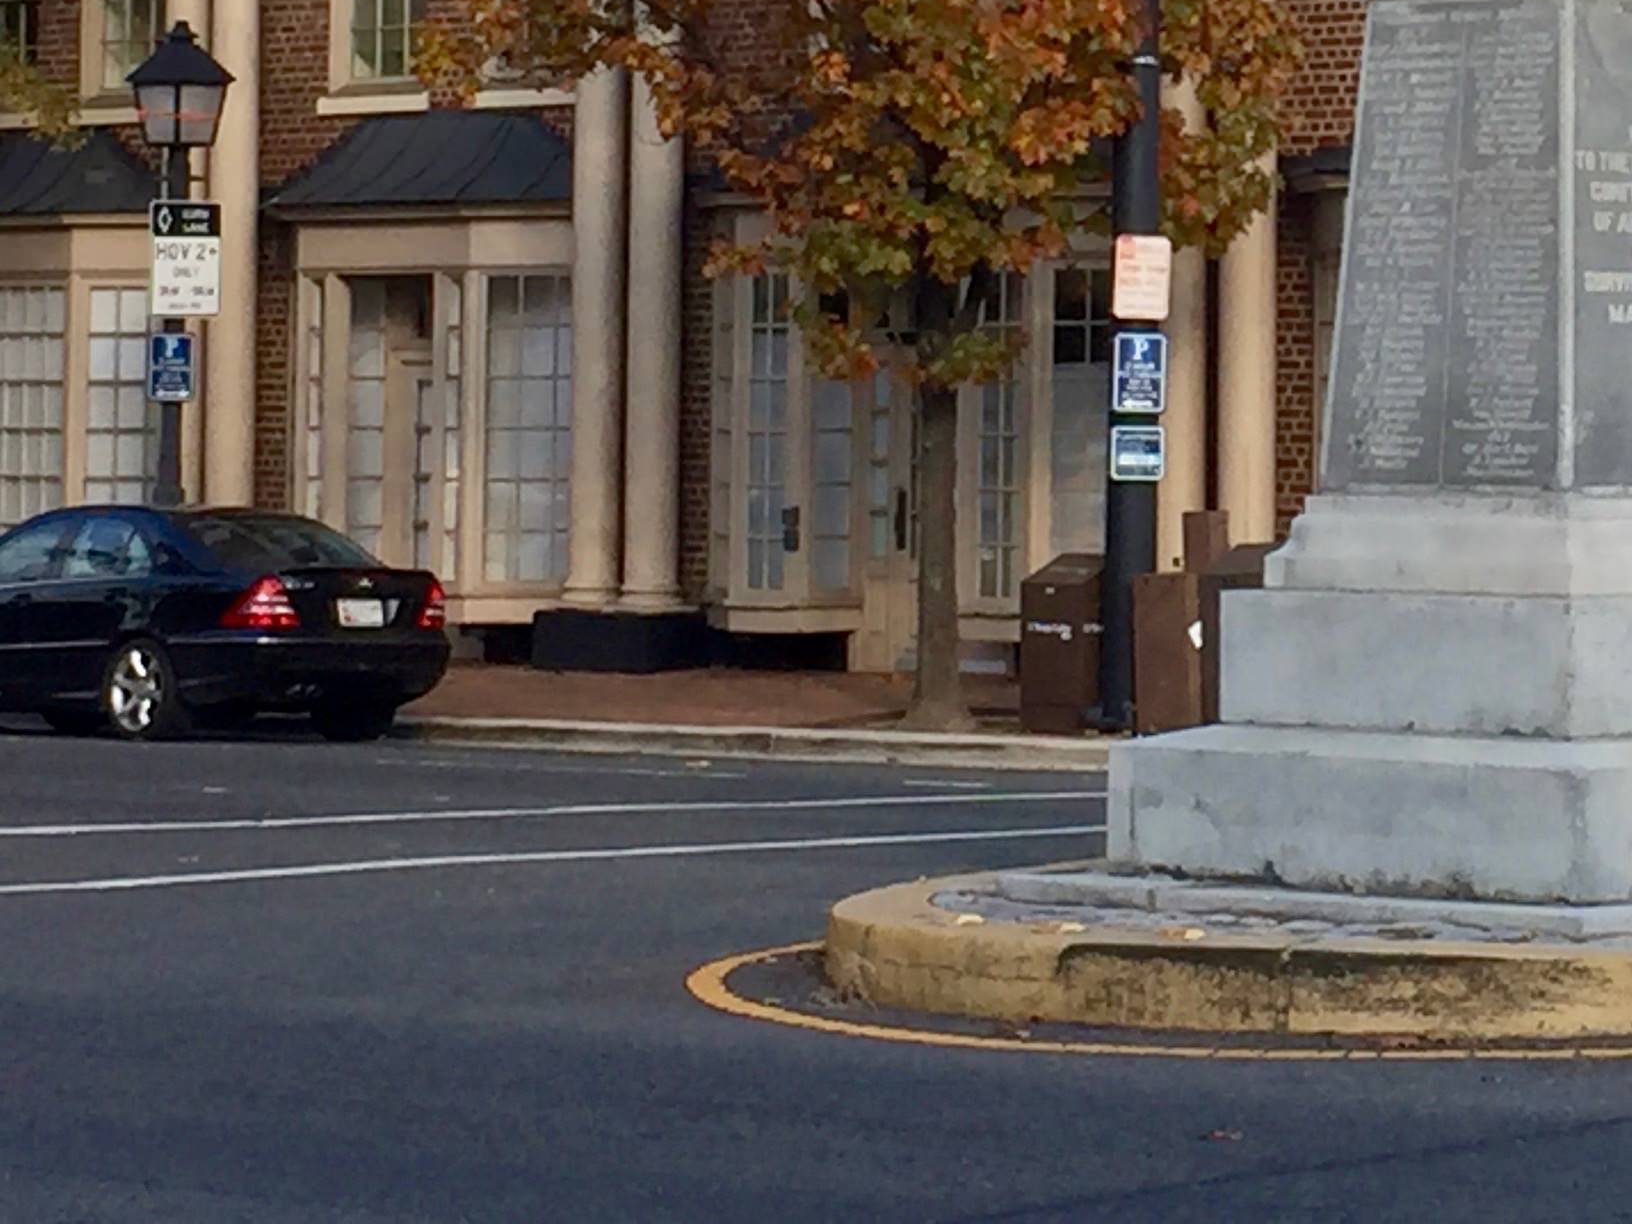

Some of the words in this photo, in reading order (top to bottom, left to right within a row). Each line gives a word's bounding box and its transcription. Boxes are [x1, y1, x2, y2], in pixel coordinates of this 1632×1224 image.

[1575, 149, 1596, 171] TO
[1599, 151, 1630, 174] THE
[1593, 210, 1613, 232] OF
[156, 242, 192, 261] HOV
[1132, 337, 1150, 361] P
